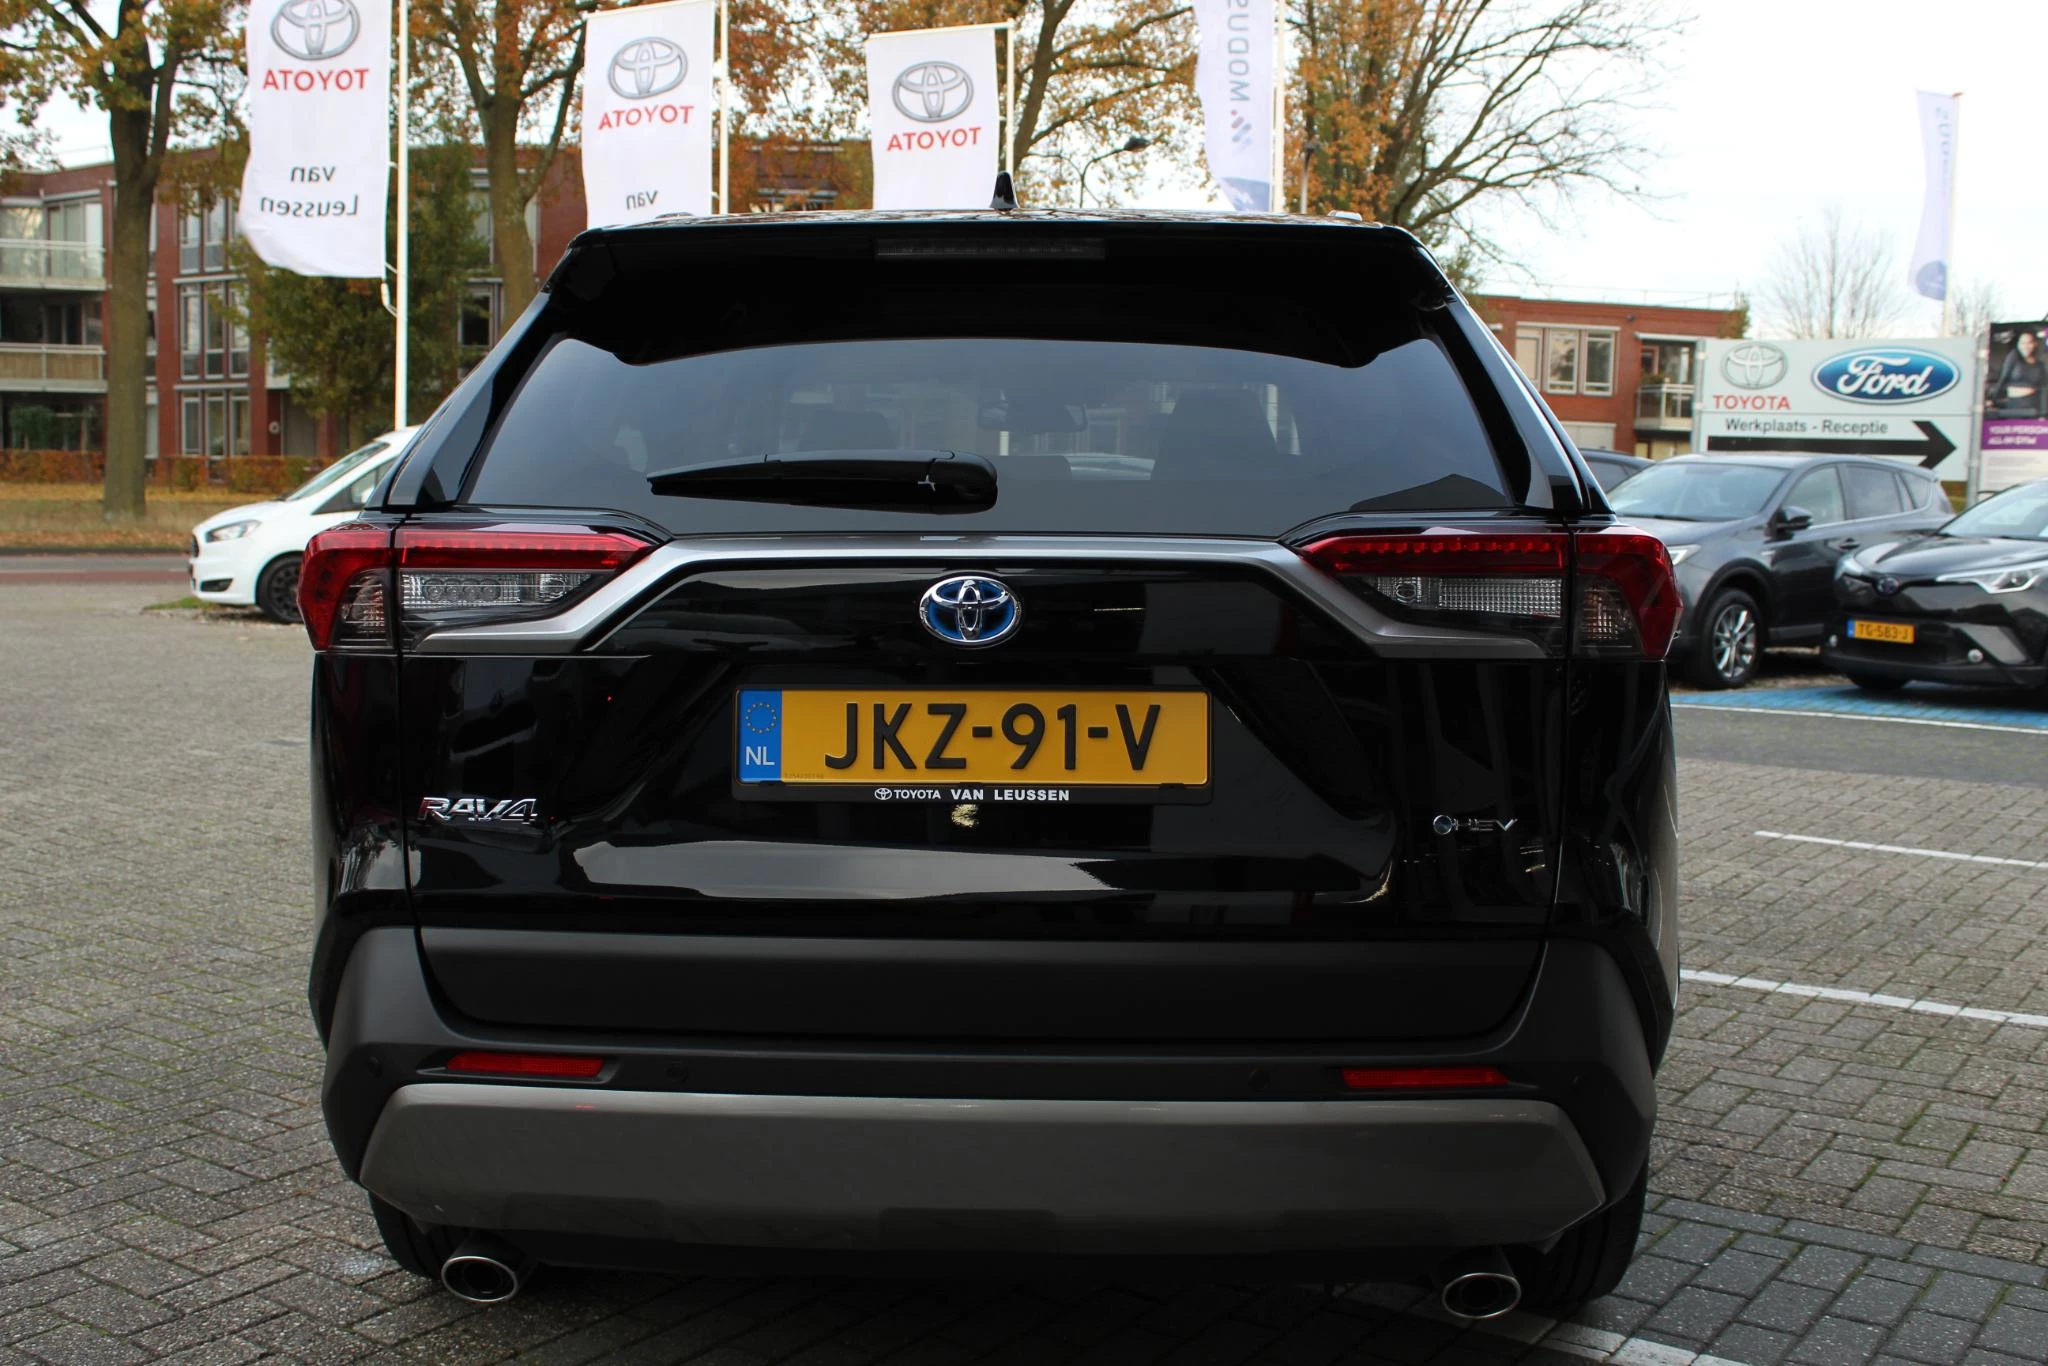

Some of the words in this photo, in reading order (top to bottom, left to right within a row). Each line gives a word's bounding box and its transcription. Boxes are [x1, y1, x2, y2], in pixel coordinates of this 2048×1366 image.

[1836, 355, 1932, 396] Ford
[1712, 394, 1791, 411] TOYOTA
[1725, 417, 1807, 434] Werkplaats
[1821, 419, 1889, 435] Receptie
[824, 702, 1161, 771] JKZ-91-V
[745, 745, 775, 766] NL
[893, 789, 942, 800] TOYOTA
[951, 789, 984, 800] VAN
[994, 789, 1070, 801] LEUSSEN
[418, 797, 538, 824] RAV4
